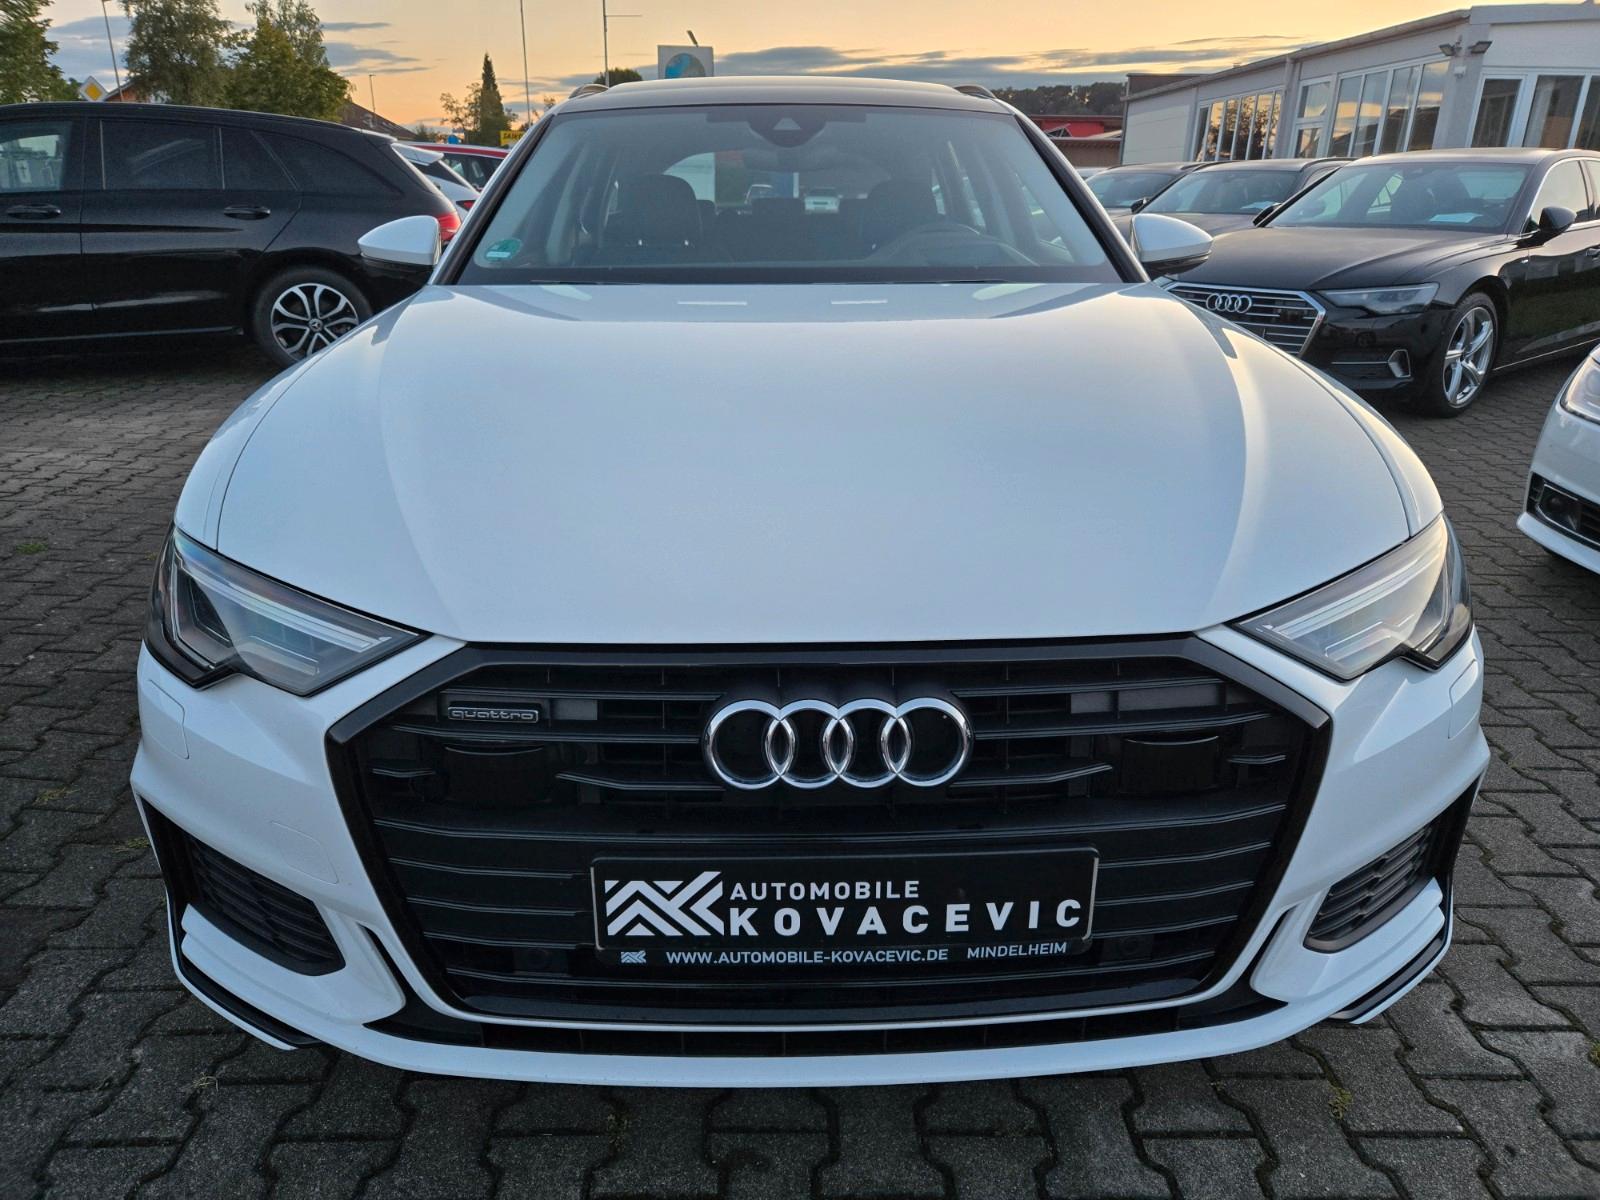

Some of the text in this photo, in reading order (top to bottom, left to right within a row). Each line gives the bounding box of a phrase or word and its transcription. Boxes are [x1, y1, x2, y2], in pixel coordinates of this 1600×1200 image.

[451, 709, 534, 720] quattro
[729, 881, 920, 901] AUTOMOBILE
[729, 899, 1081, 937] KOVACEVIC
[666, 941, 1067, 964] WWW.AUTOMOBILE-KOVACEVIC.DE MINDELHEIM
